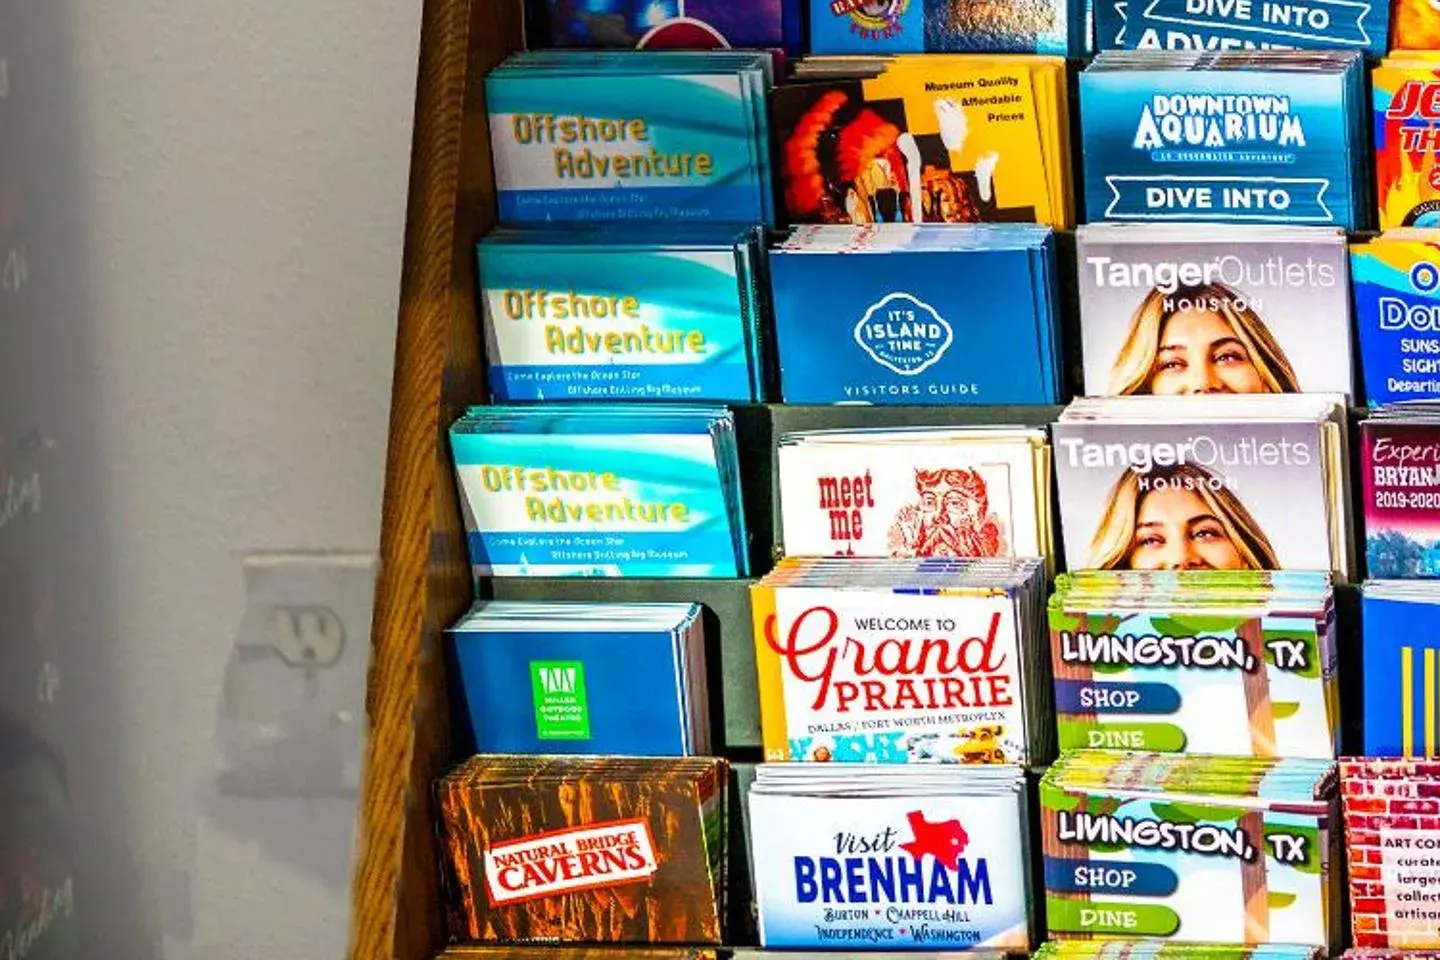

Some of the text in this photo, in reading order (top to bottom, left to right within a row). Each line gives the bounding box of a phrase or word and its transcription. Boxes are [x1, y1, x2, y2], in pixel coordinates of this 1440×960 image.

[961, 93, 1022, 107] Affordable
[1153, 95, 1289, 116] DOWNTOWN
[511, 112, 648, 142] Offshore
[987, 111, 1025, 124] Prices
[554, 147, 714, 179] Adventure
[1146, 186, 1291, 209] DIVE INTO
[503, 290, 640, 321] Offshore
[1163, 297, 1266, 313] HOUSTON
[544, 325, 707, 356] Adventure
[865, 320, 942, 340] ISLAND
[480, 465, 620, 494] Offshore
[818, 468, 875, 509] meet
[1374, 466, 1433, 488] BRYAN
[854, 618, 956, 633] WELCOME TO
[764, 606, 1006, 711] Grand
[1080, 688, 1140, 710] SHOP
[493, 832, 637, 868] NATURAL BRIDGE
[833, 830, 897, 855] Visit
[1385, 838, 1411, 847] ART
[1074, 866, 1138, 889] SHOP
[1080, 908, 1138, 929] DINE
